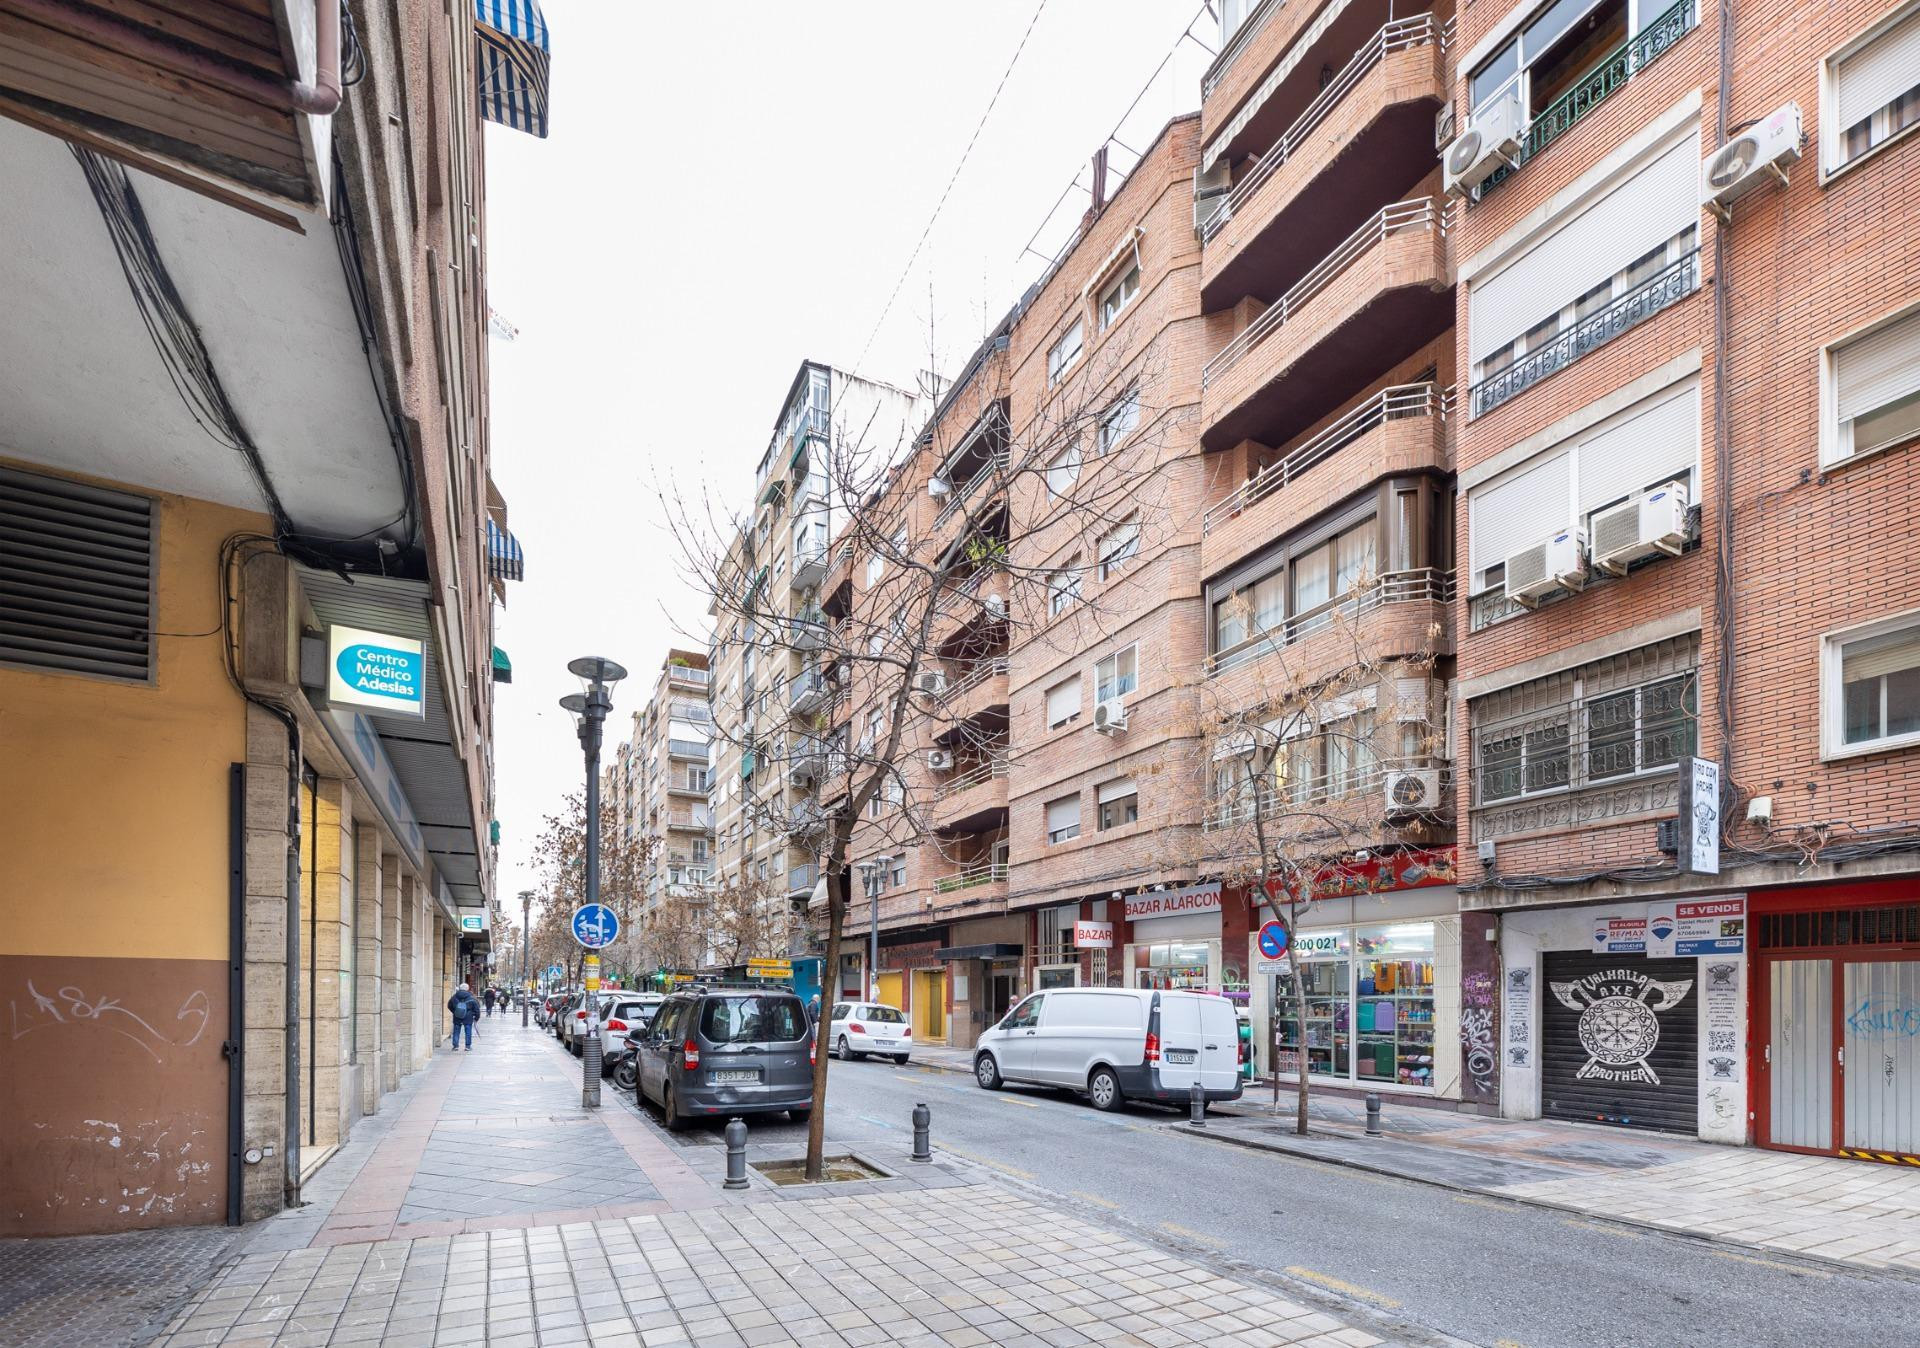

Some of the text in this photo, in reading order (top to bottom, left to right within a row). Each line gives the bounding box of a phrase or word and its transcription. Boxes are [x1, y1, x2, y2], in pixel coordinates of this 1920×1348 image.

[357, 649, 408, 667] Centro
[356, 662, 412, 681] Médico
[357, 676, 414, 695] Adeslas
[1125, 891, 1221, 916] BAZAR ALARCON
[1680, 903, 1740, 915] SE VENDE
[1078, 929, 1112, 941] BAZAR
[1316, 937, 1337, 949] 021
[1581, 969, 1648, 990] VALHALLA
[1600, 985, 1633, 996] AXE
[717, 1071, 738, 1080] 8351
[1584, 1064, 1652, 1083] BROTHER
